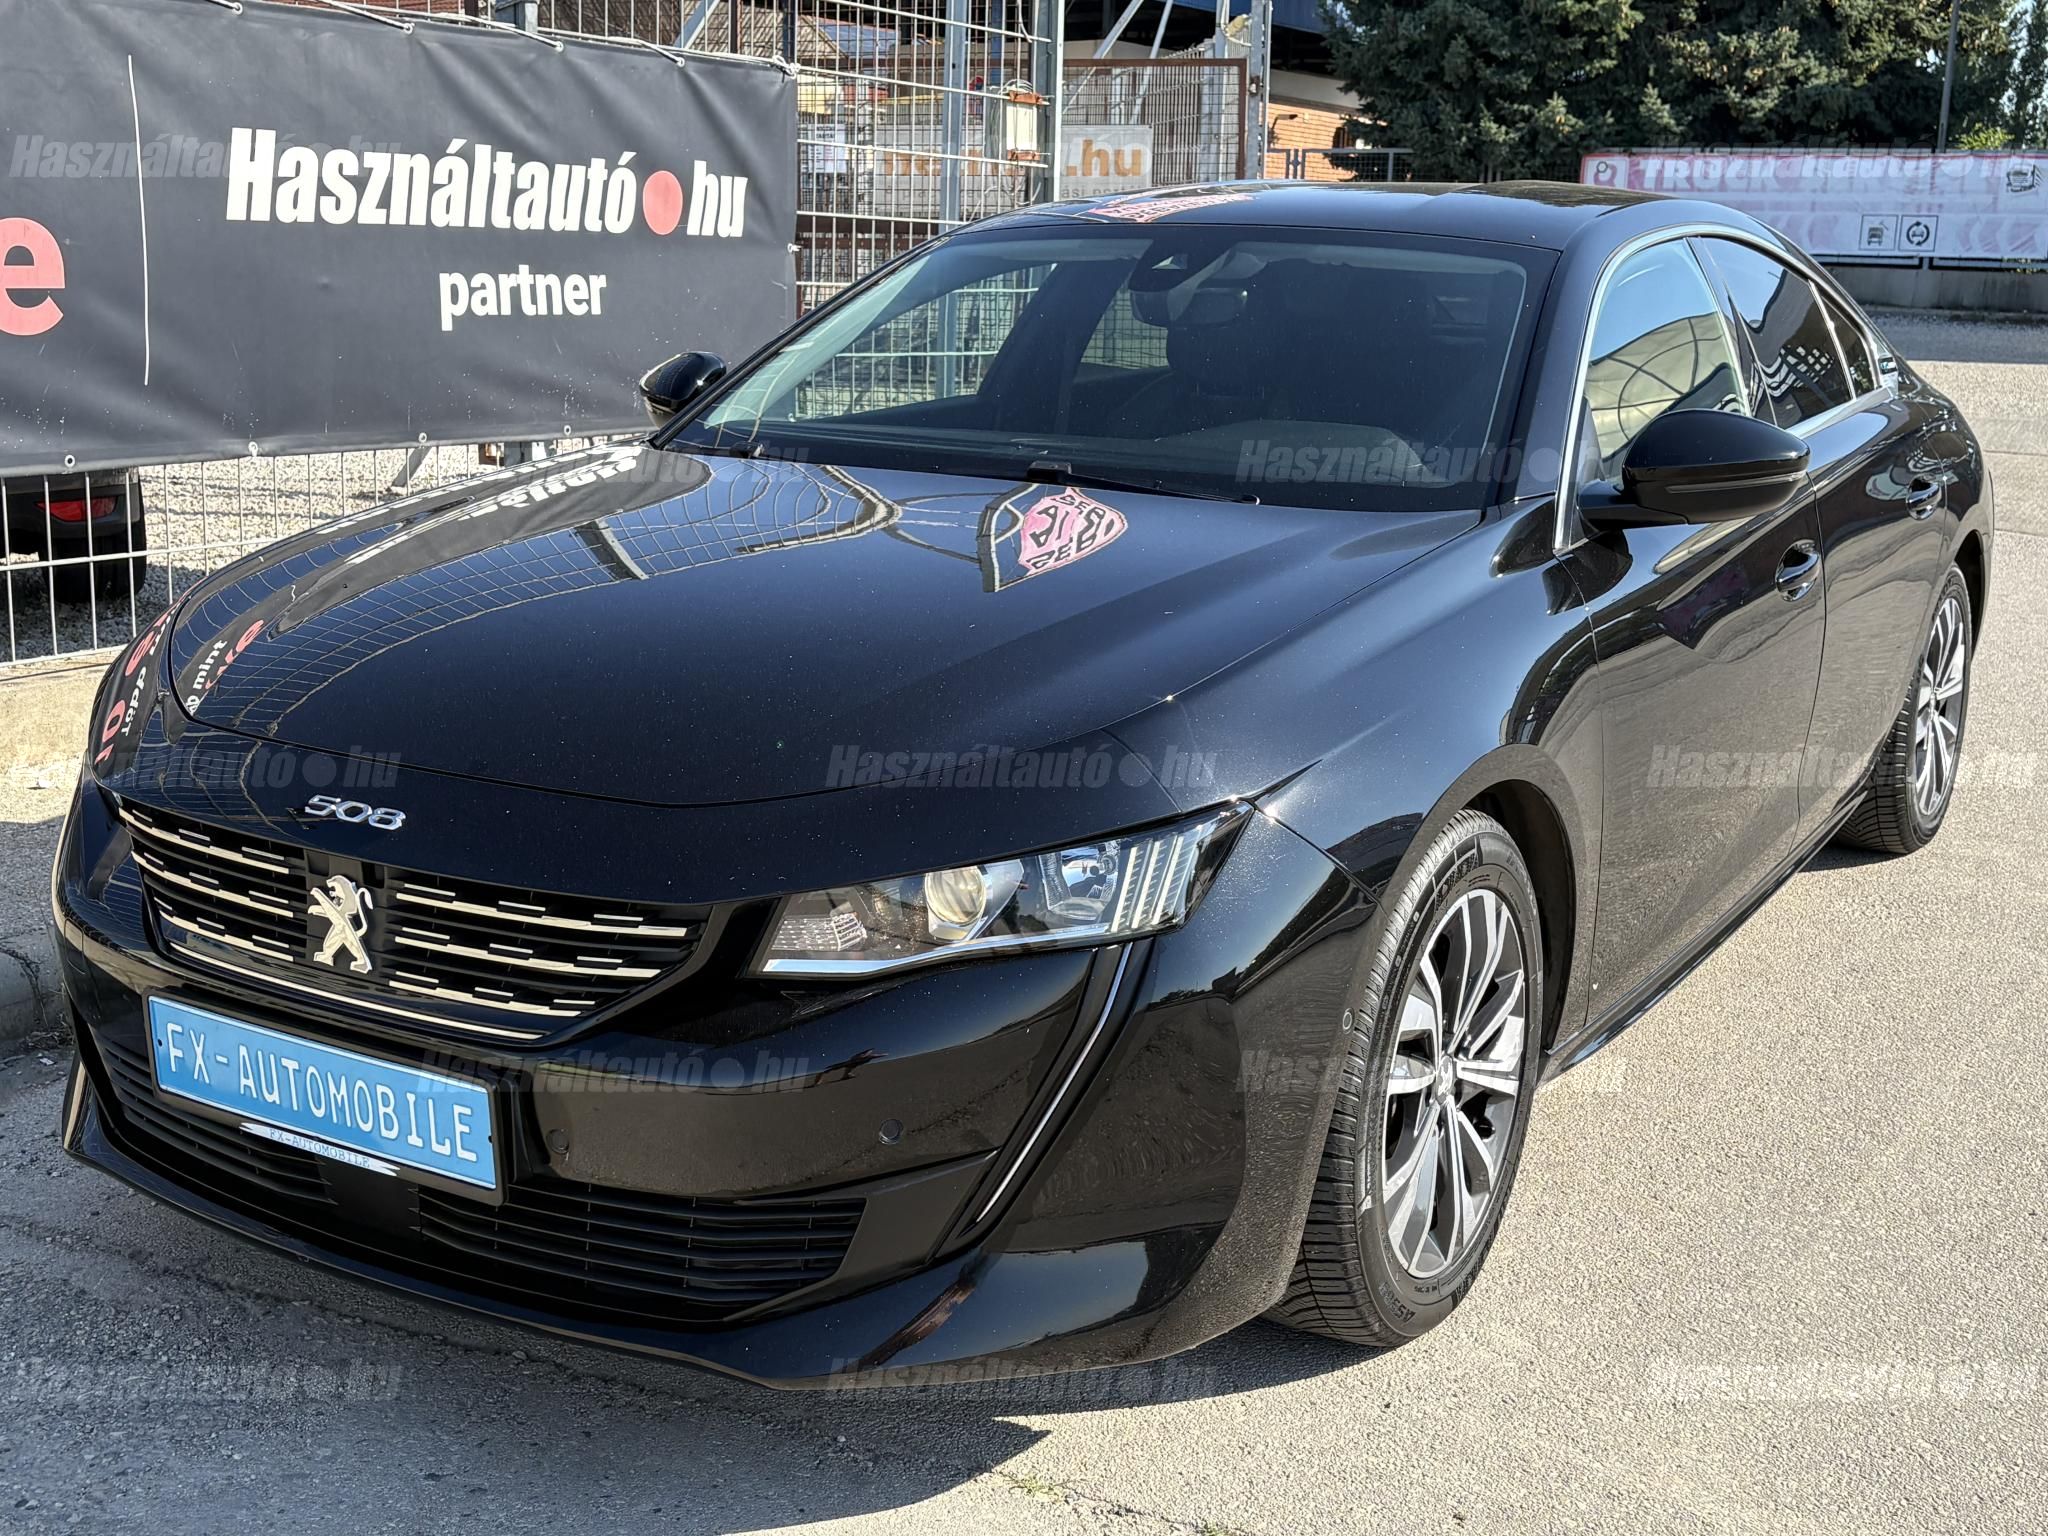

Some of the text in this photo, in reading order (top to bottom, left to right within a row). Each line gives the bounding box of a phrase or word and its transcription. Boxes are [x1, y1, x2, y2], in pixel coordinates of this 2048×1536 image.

[440, 264, 608, 331] partner
[304, 794, 406, 831] 508
[166, 1022, 478, 1162] FX-AUTOMOBILE
[268, 1127, 371, 1169] FX-AUTOMOBILE
